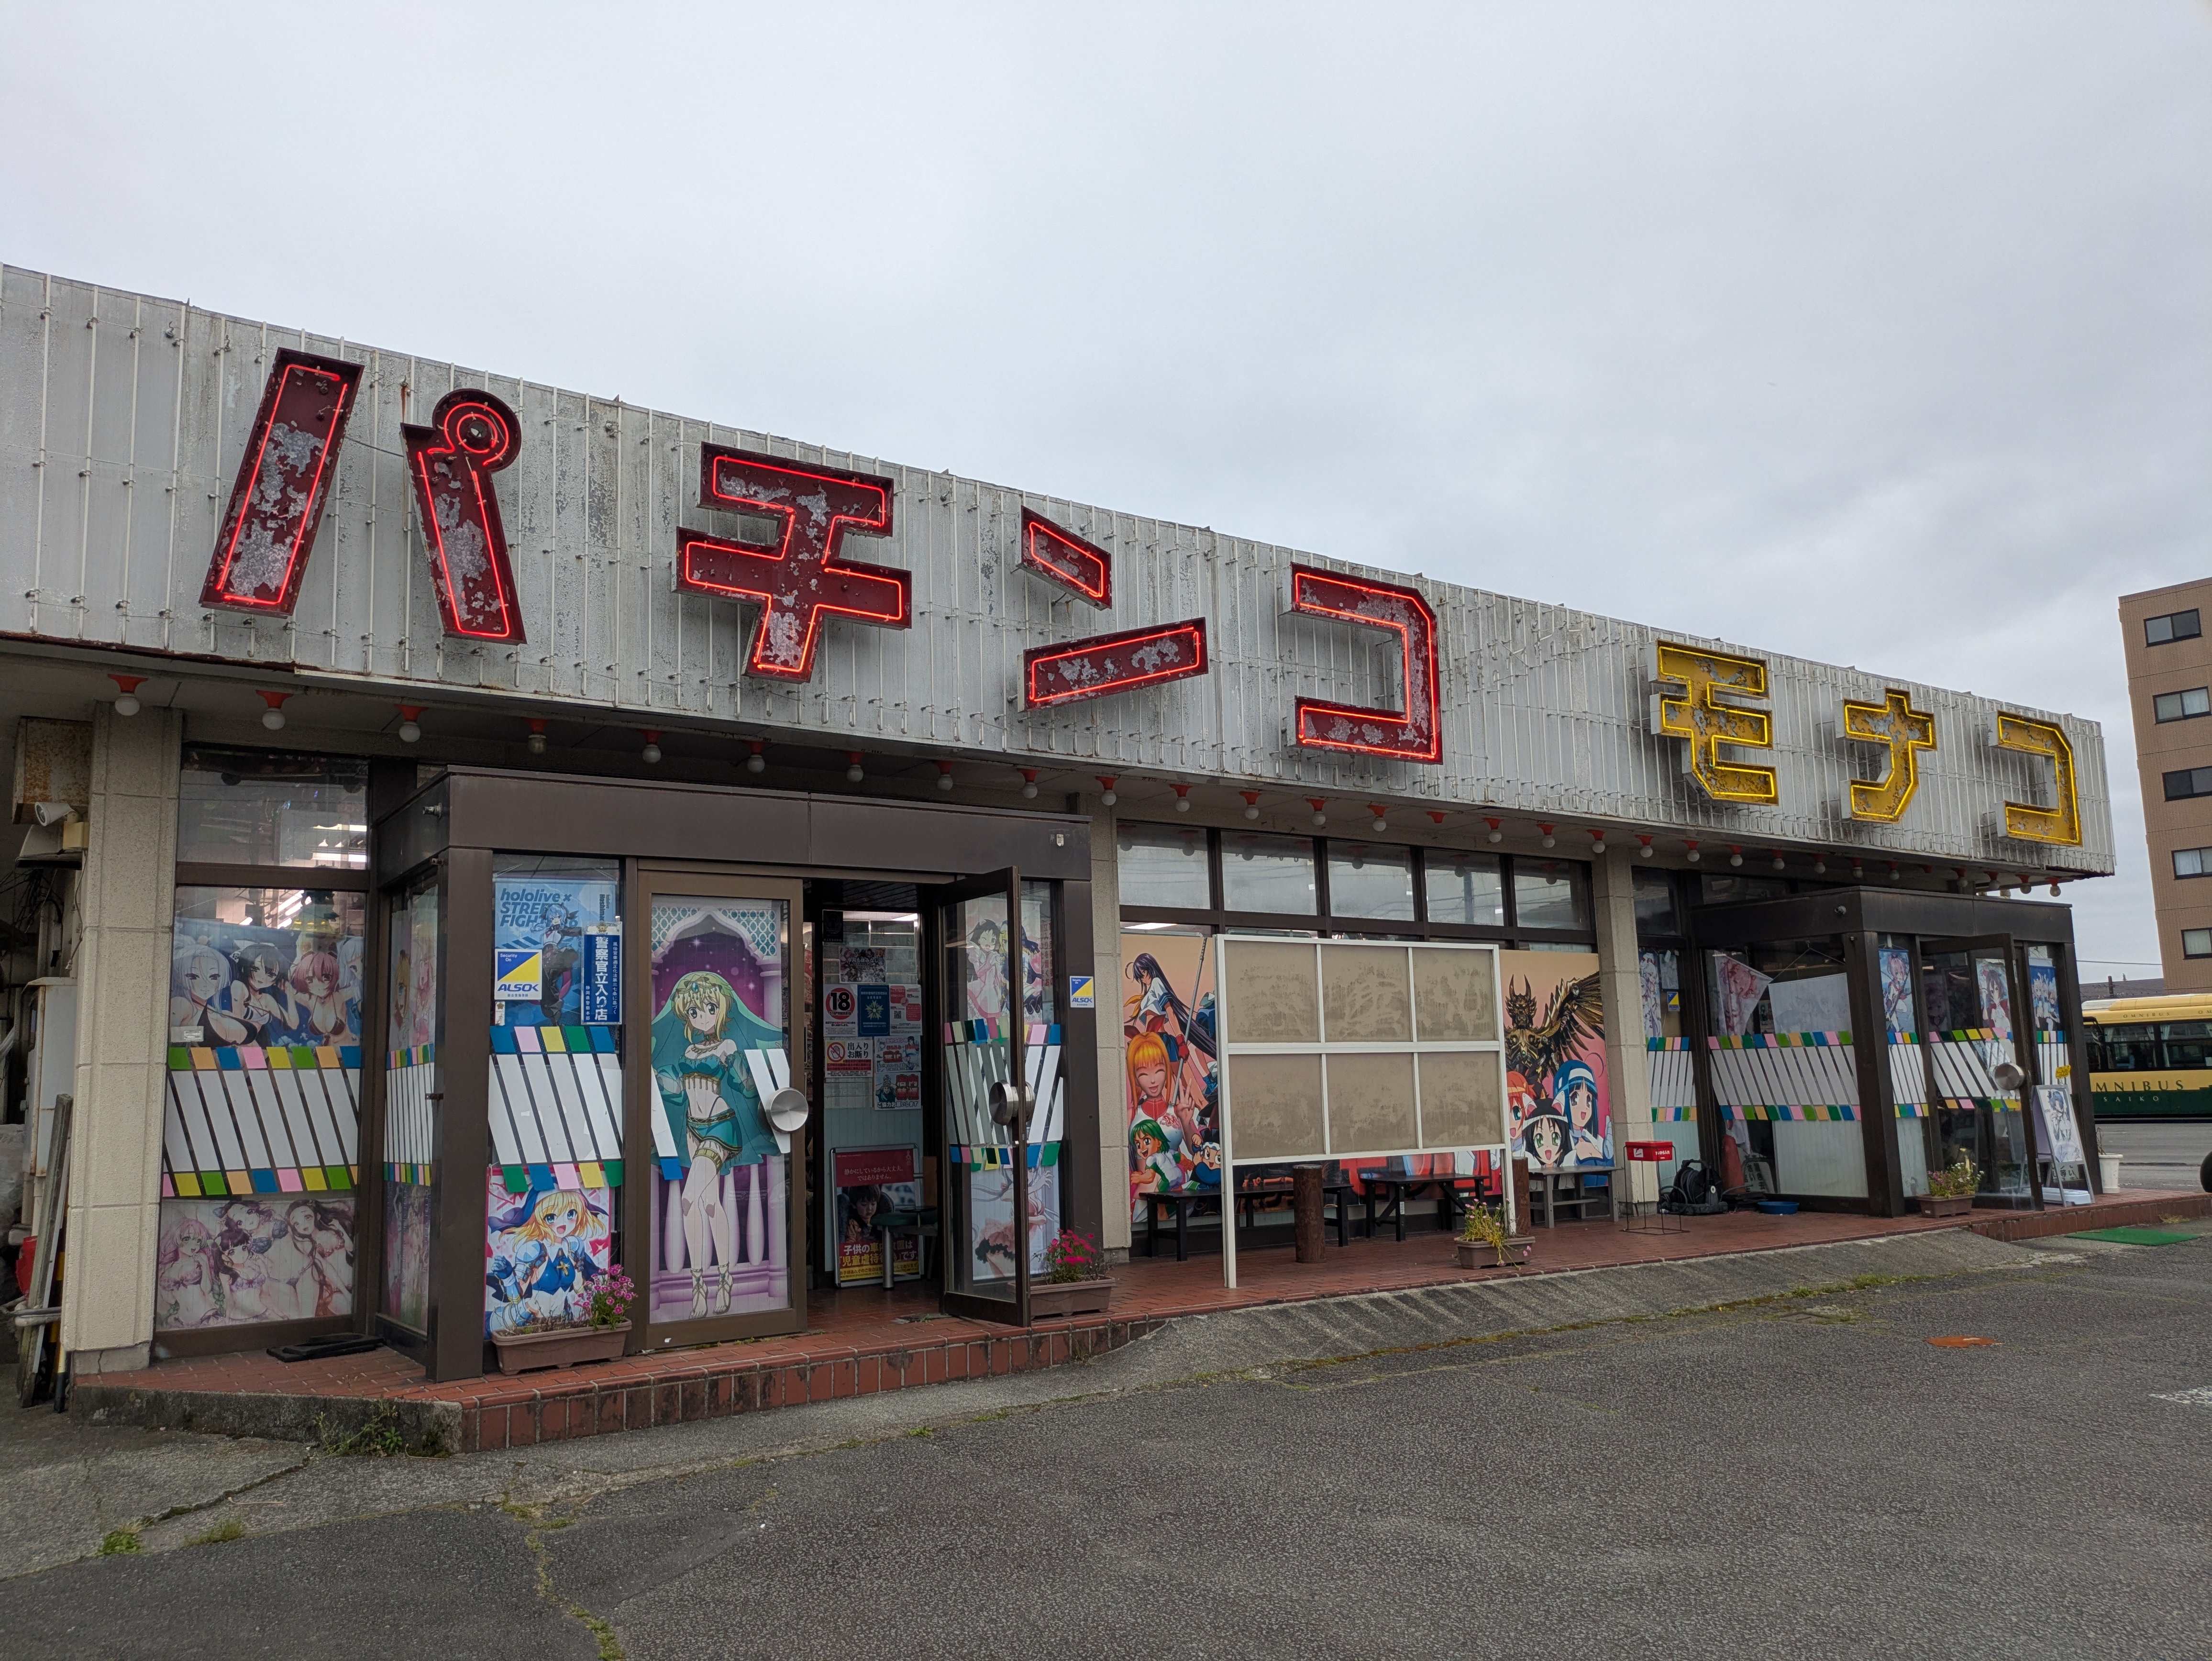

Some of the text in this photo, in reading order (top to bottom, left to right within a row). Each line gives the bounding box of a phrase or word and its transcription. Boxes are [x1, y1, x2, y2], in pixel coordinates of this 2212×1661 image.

[199, 348, 2083, 847] パチンコ モナコ
[500, 888, 560, 902] hololive
[595, 936, 608, 1021] 警察官立入り店
[498, 984, 539, 992] ALSOK
[830, 992, 850, 1011] 18
[848, 1042, 869, 1051] 出入り
[848, 1051, 869, 1059] お断り
[2096, 1080, 2184, 1092] MNIBUS
[844, 1165, 903, 1175] 静かにしているから大丈夫。
